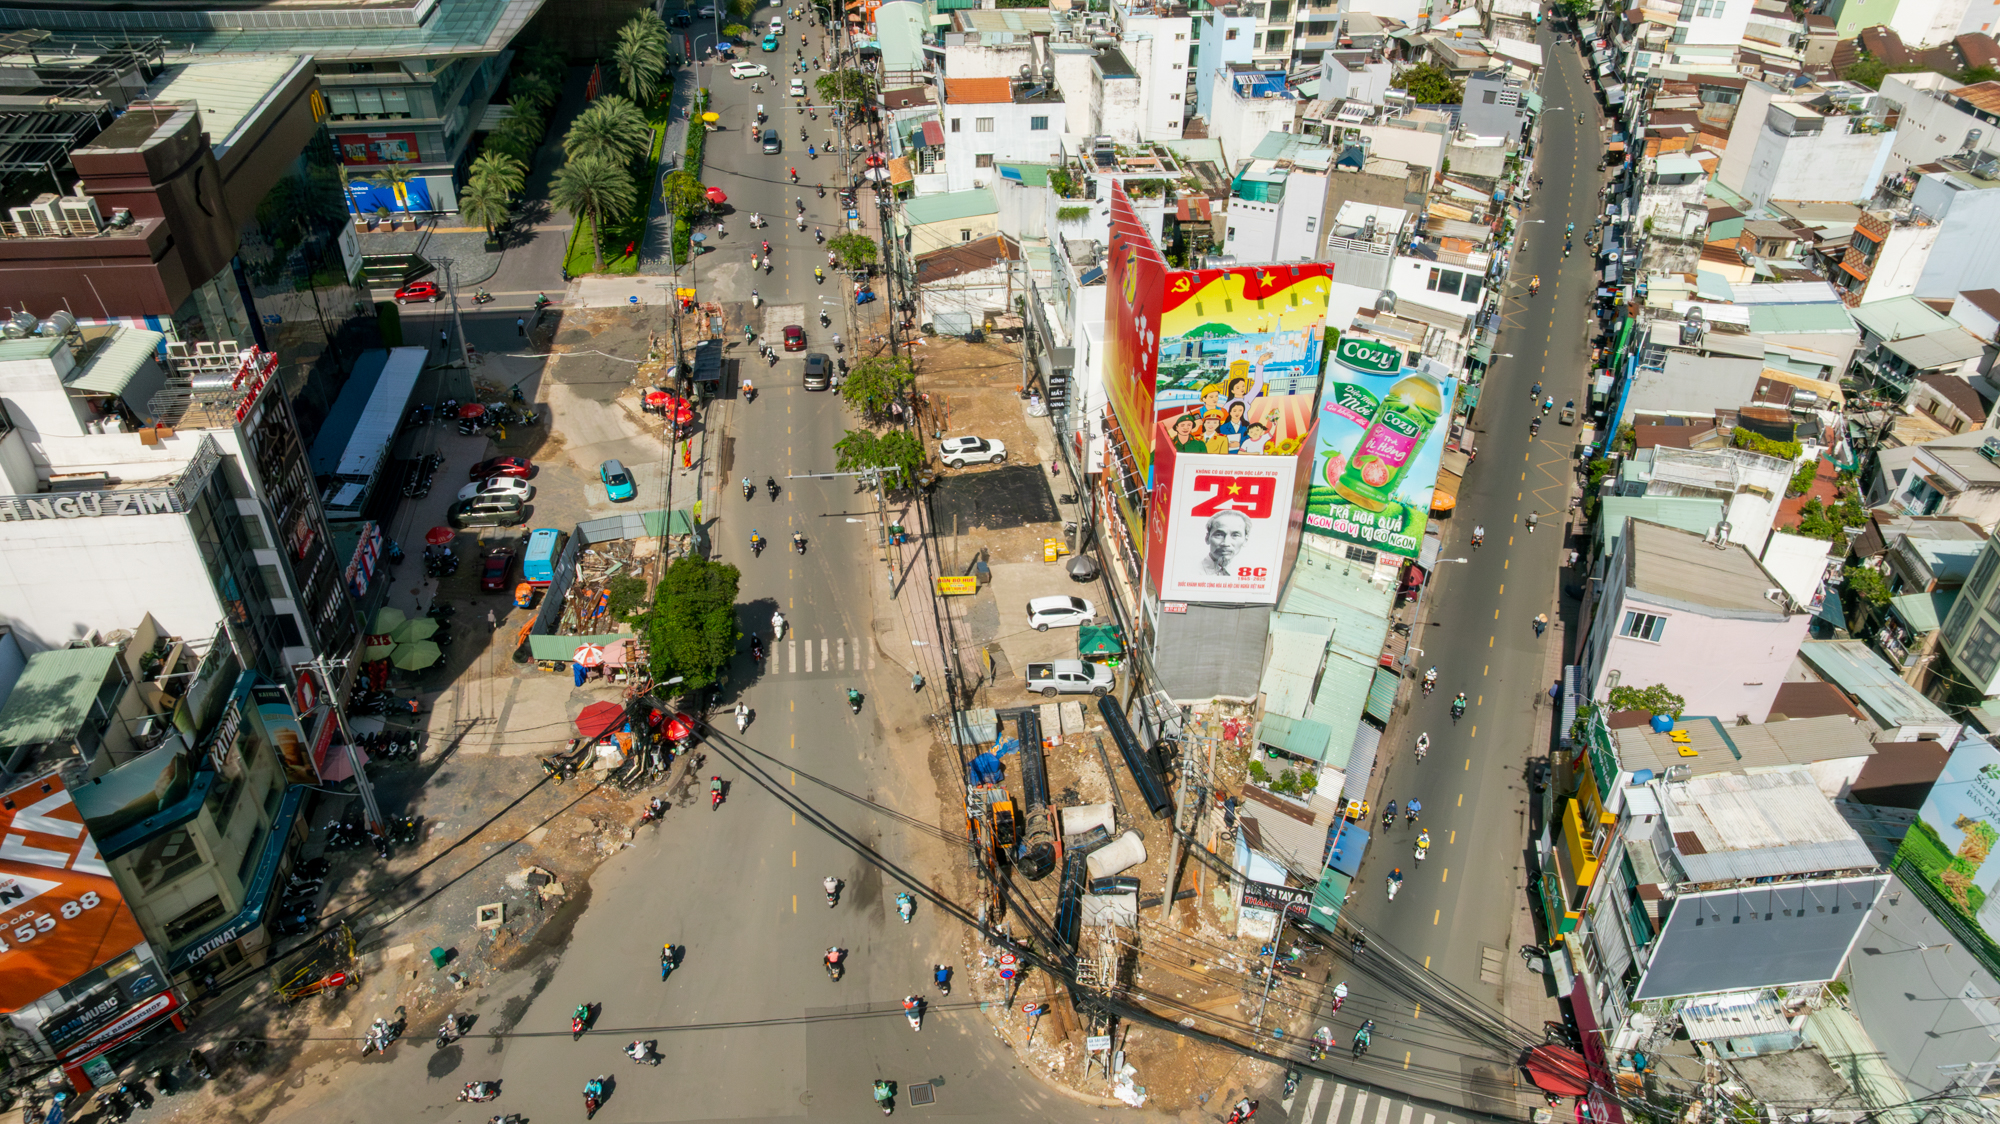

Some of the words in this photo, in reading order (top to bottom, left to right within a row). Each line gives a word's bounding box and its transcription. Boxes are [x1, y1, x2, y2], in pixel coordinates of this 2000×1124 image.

[1343, 341, 1395, 369] Cozy
[1339, 392, 1373, 416] Mới
[1344, 385, 1362, 398] Diện
[1384, 412, 1416, 435] Cozy
[26, 491, 102, 520] NGỮ
[111, 492, 174, 516] ZIM
[1306, 513, 1333, 530] NGON
[1333, 519, 1349, 533] RÕ
[1347, 523, 1360, 538] VỊ
[1361, 526, 1374, 541] VỊ
[1373, 528, 1390, 542] RÕ
[1388, 533, 1416, 550] NGON
[1352, 511, 1375, 525] HOA
[1378, 515, 1403, 532] QUẢ
[208, 698, 242, 773] KATINAT
[1975, 774, 1996, 797] Sản
[11, 910, 35, 927] CÁO
[14, 913, 56, 943] 55
[60, 891, 100, 920] 88
[187, 926, 237, 964] KATINAT
[112, 1001, 162, 1035] BARBERSHOP
